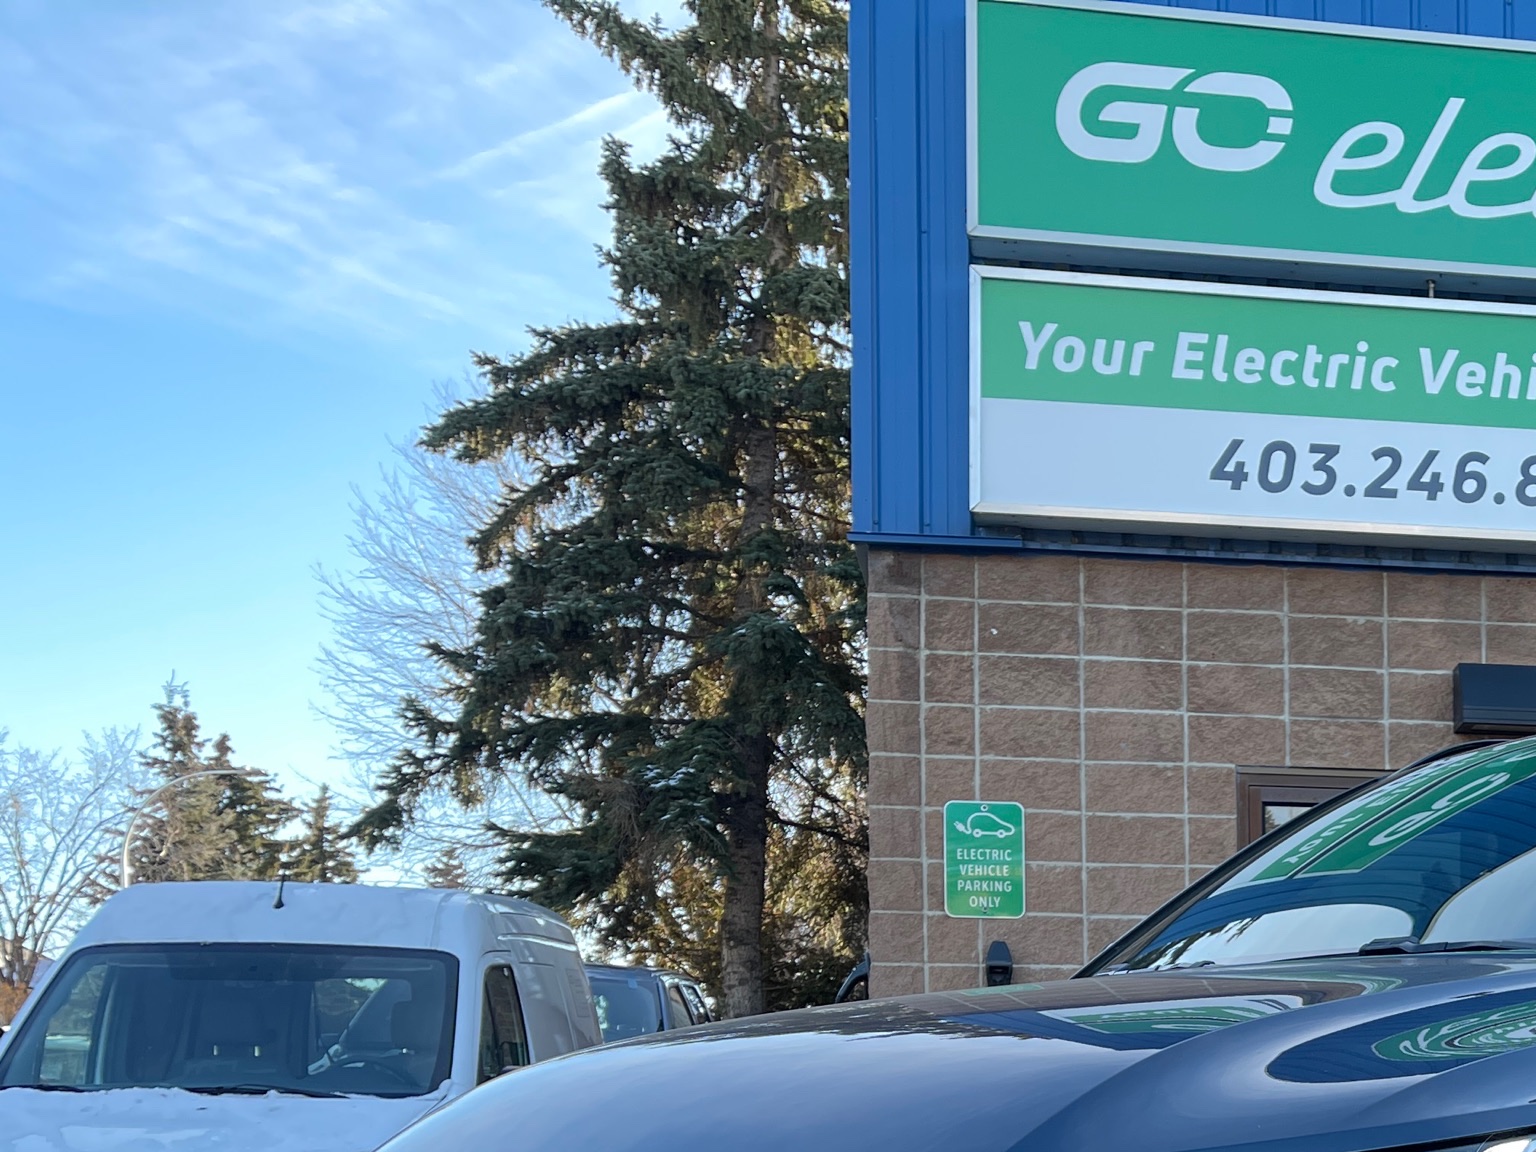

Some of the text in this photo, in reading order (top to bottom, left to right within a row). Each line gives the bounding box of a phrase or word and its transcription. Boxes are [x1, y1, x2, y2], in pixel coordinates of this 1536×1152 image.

[1055, 61, 1294, 173] GO
[1018, 320, 1155, 377] Your
[1171, 331, 1400, 393] Electric
[956, 848, 1012, 861] ELECTRIC
[959, 864, 1010, 876] VEHICLE
[957, 880, 1012, 892] PARKING
[969, 896, 1001, 907] ONLY
